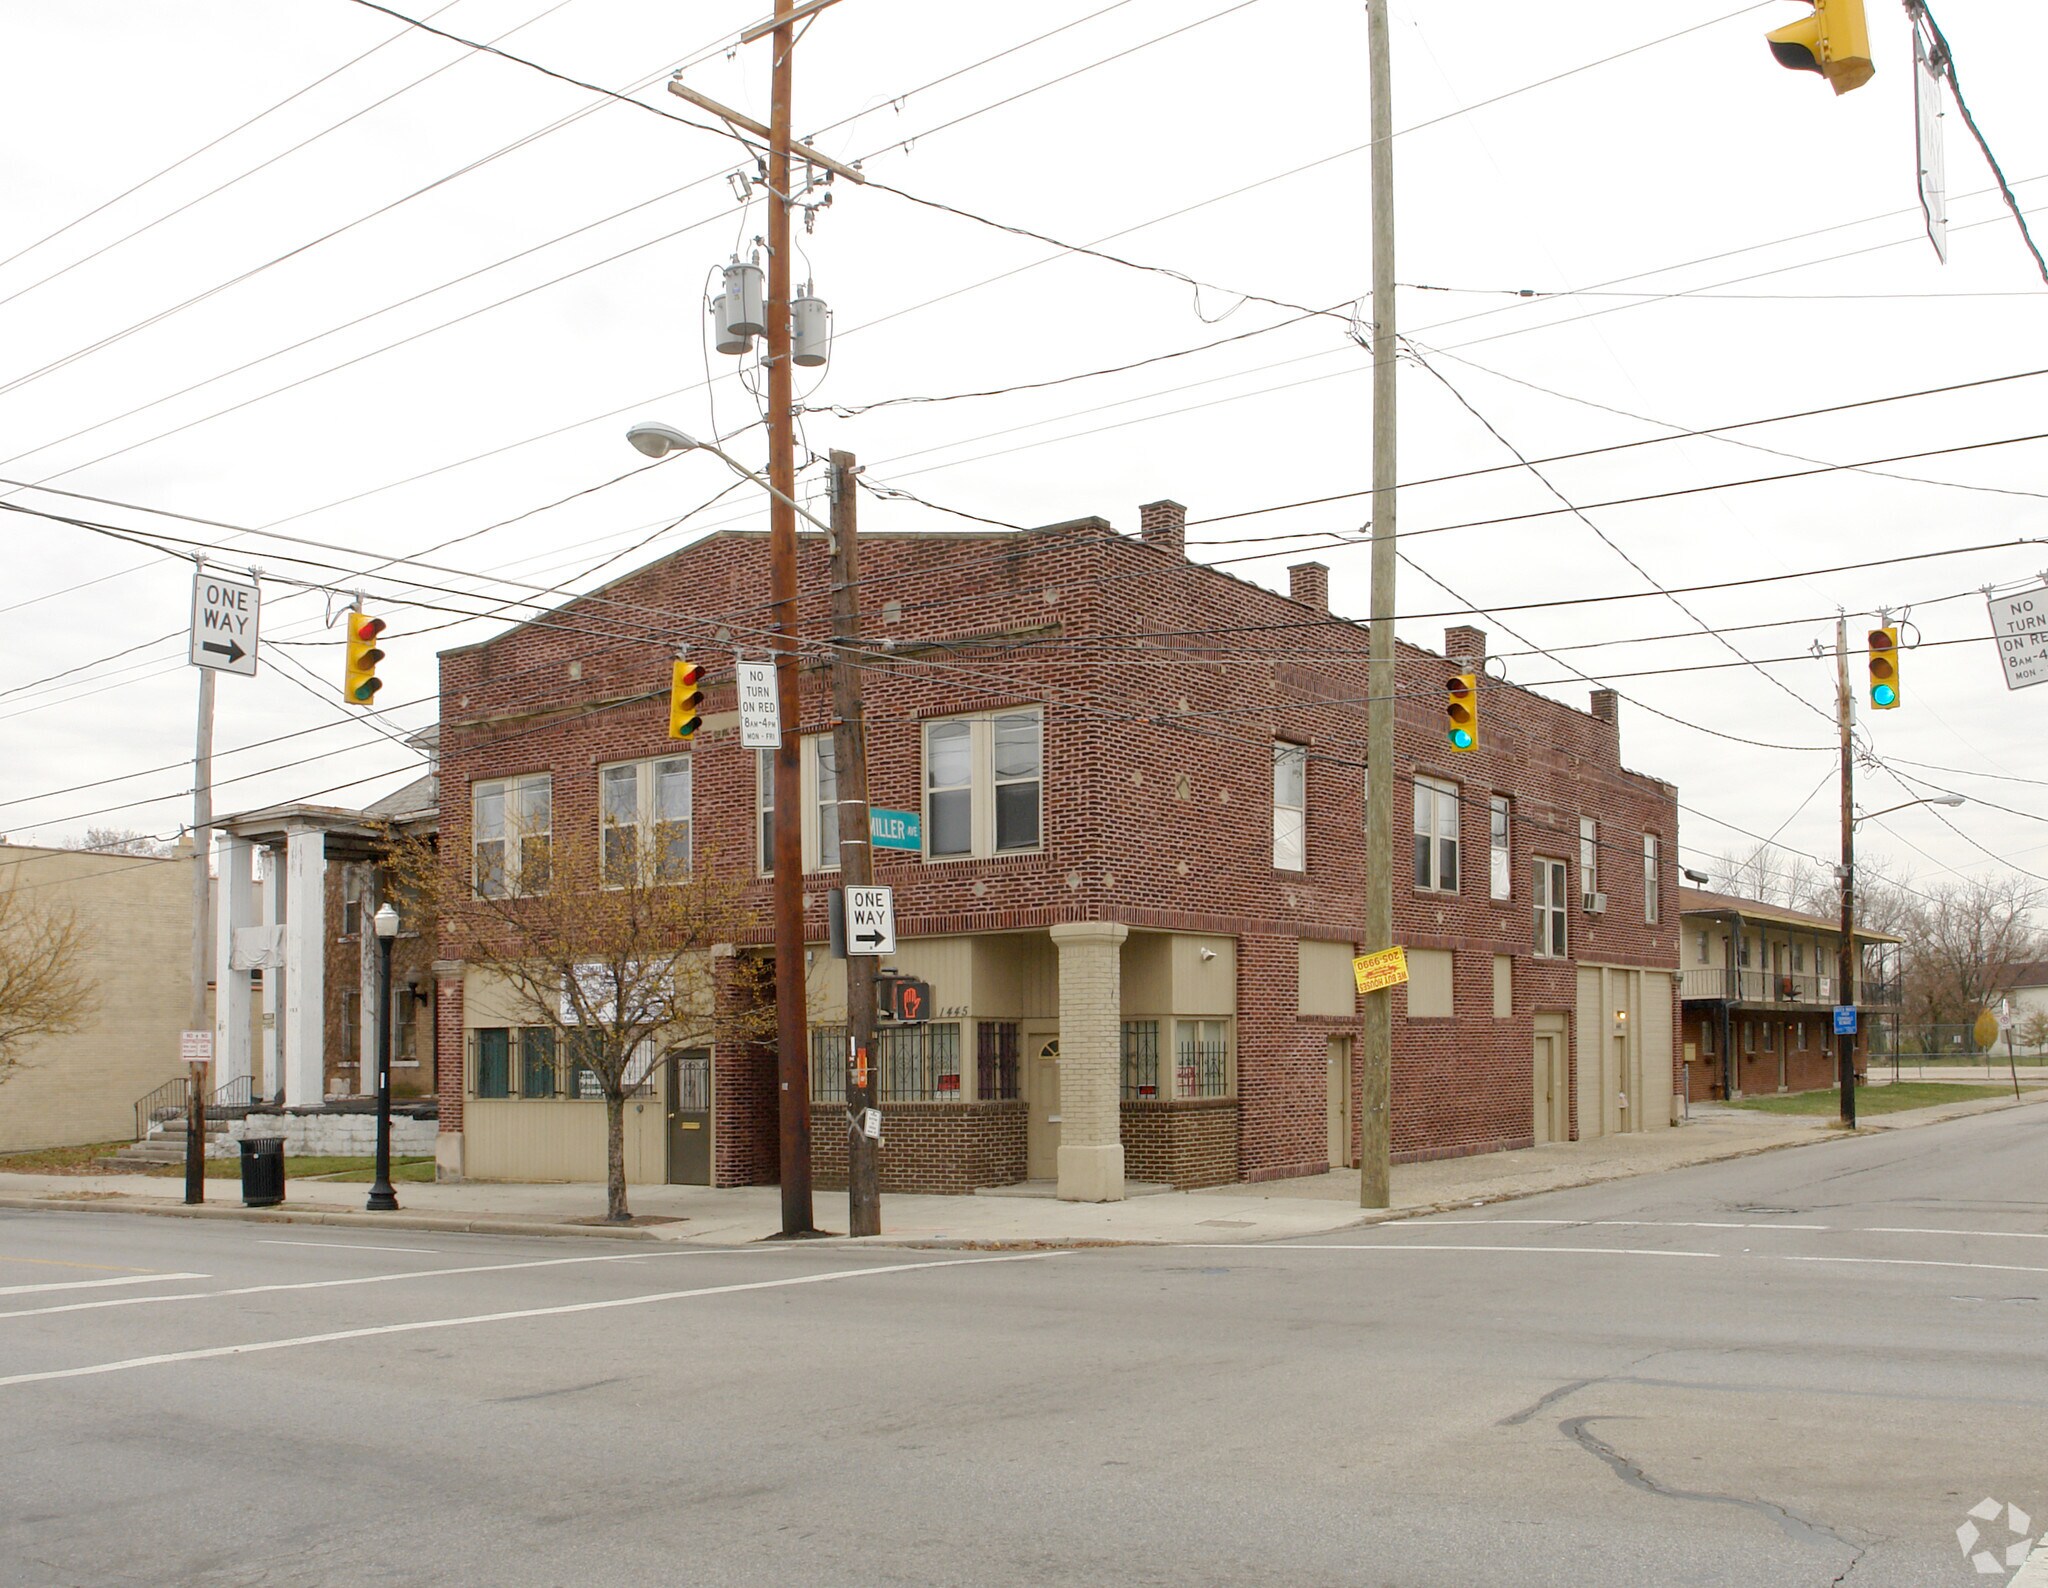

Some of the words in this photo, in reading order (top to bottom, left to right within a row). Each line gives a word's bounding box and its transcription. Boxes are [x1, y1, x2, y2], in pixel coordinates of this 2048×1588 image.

[207, 584, 248, 612] ONE
[2010, 600, 2034, 616] NO
[204, 607, 249, 636] WAY
[2007, 614, 2047, 633] TURN
[2003, 637, 2024, 652] ON
[2030, 631, 2048, 646] RE
[2009, 648, 2048, 668] 8AM-4
[749, 670, 764, 682] NO
[2015, 668, 2036, 680] MON
[746, 685, 770, 698] TURN
[742, 701, 755, 713] ON
[758, 702, 776, 713] RED
[744, 717, 776, 728] 8AM-4PM
[747, 732, 760, 740] MON
[907, 825, 918, 837] AVE
[855, 892, 884, 907] ONE
[854, 910, 885, 925] WAY
[1357, 951, 1400, 970] 205-9990
[1385, 973, 1397, 985] BUY
[1397, 970, 1407, 981] WE
[1359, 977, 1383, 992] HOUSES
[939, 1006, 969, 1017] 1445
